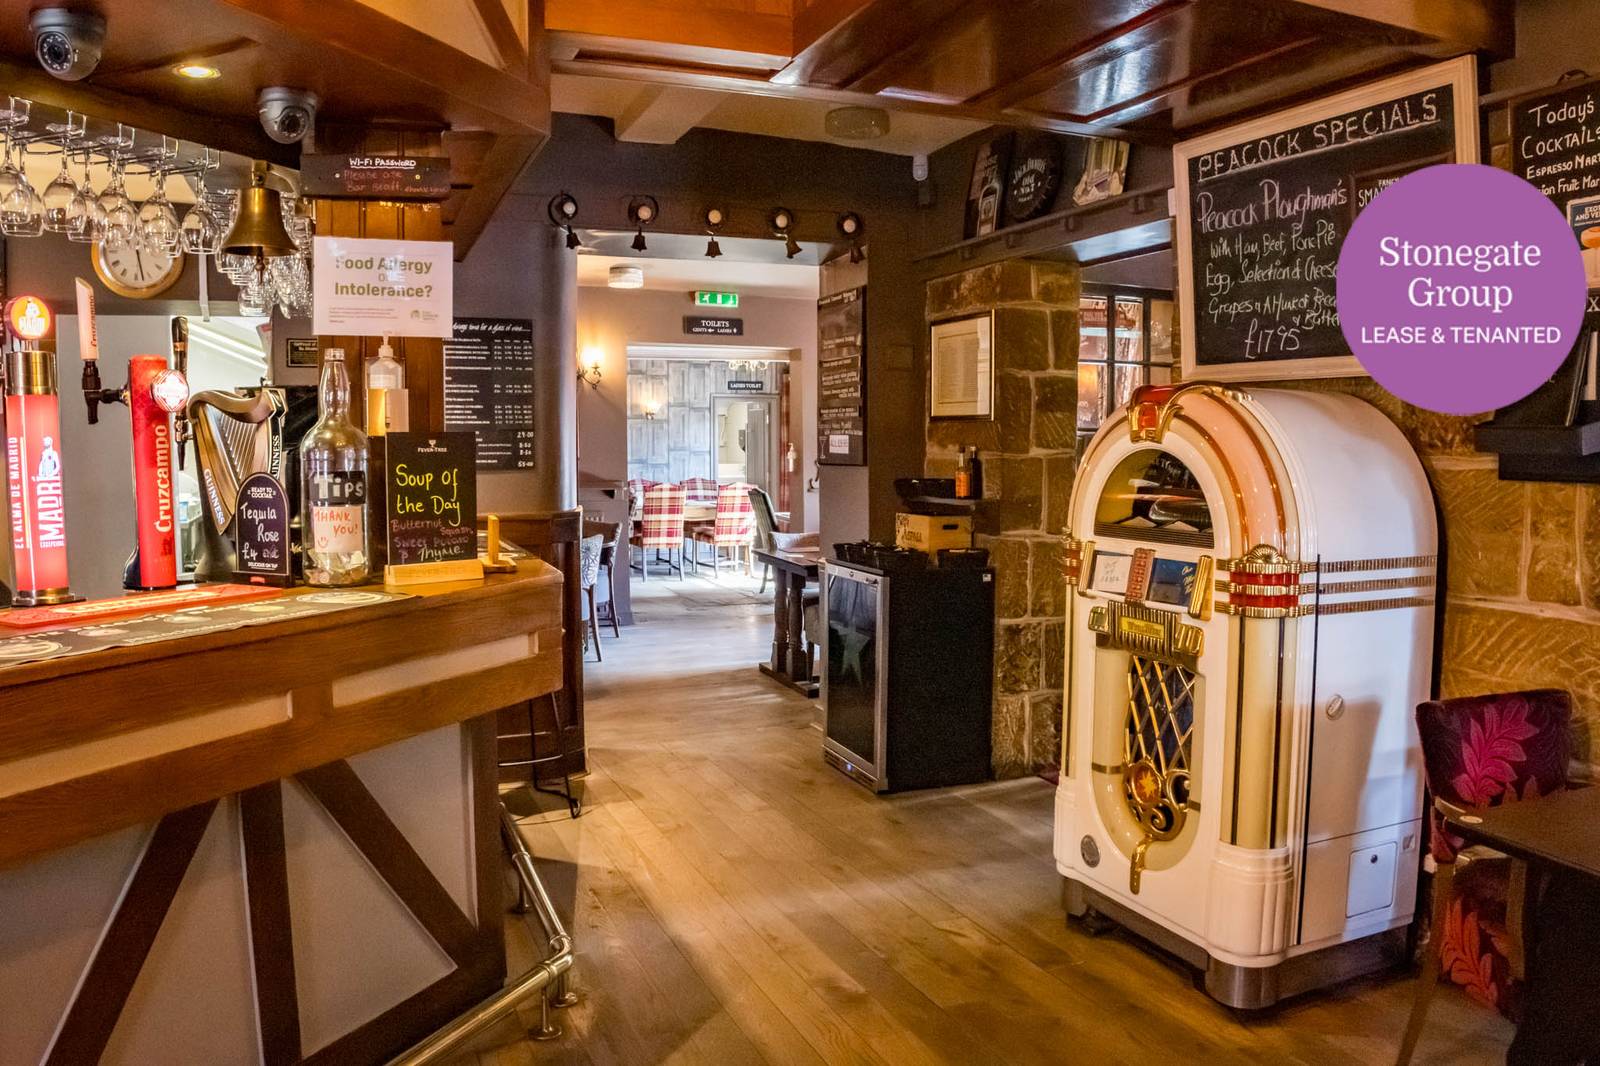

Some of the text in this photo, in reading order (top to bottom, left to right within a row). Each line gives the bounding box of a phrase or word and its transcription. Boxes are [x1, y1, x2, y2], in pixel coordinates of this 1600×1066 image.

[1528, 95, 1595, 127] Today's
[1198, 93, 1438, 181] PEACOCK SPECIALS
[374, 157, 417, 168] PASSWORD
[1526, 161, 1573, 180] ESPRESSO
[1557, 178, 1580, 193] Fruit
[1197, 191, 1260, 233] Peacock
[1210, 236, 1232, 259] with
[334, 282, 433, 298] Intolerance?
[1205, 262, 1235, 297] Egg,
[1208, 296, 1254, 324] Grapes
[700, 320, 730, 328] TOILETS
[154, 424, 172, 533] Cruzcampo
[395, 463, 434, 491] Soup
[8, 436, 24, 549] EL ALMA DE MADRID
[203, 467, 225, 526] GUINNESS
[240, 502, 277, 525] Tequila
[314, 510, 351, 522] THANK
[396, 494, 461, 527] the Day
[257, 522, 279, 543] Rose
[390, 518, 442, 533] Butternut
[241, 542, 258, 560] £4
[393, 535, 469, 549] Sweet Potato
